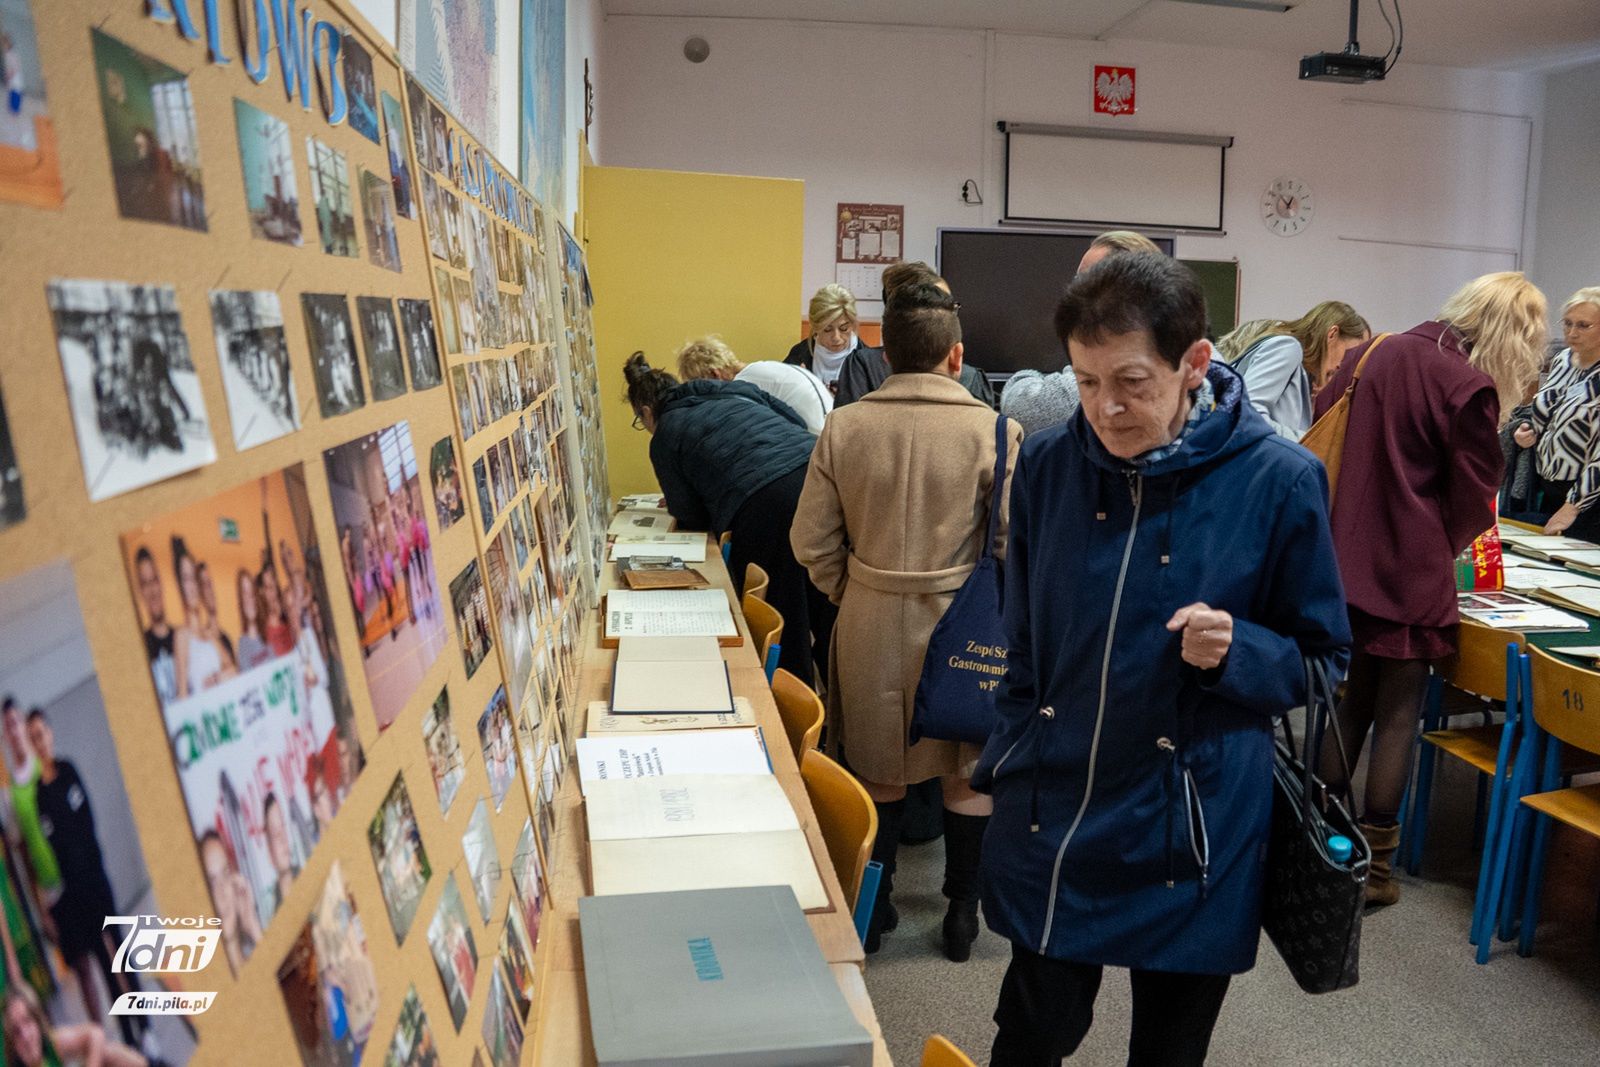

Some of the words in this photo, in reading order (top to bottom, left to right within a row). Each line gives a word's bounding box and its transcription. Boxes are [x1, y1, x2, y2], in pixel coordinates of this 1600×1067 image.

[966, 640, 994, 657] Zespó
[994, 646, 1008, 659] Sz
[979, 681, 989, 691] w
[989, 680, 999, 691] P
